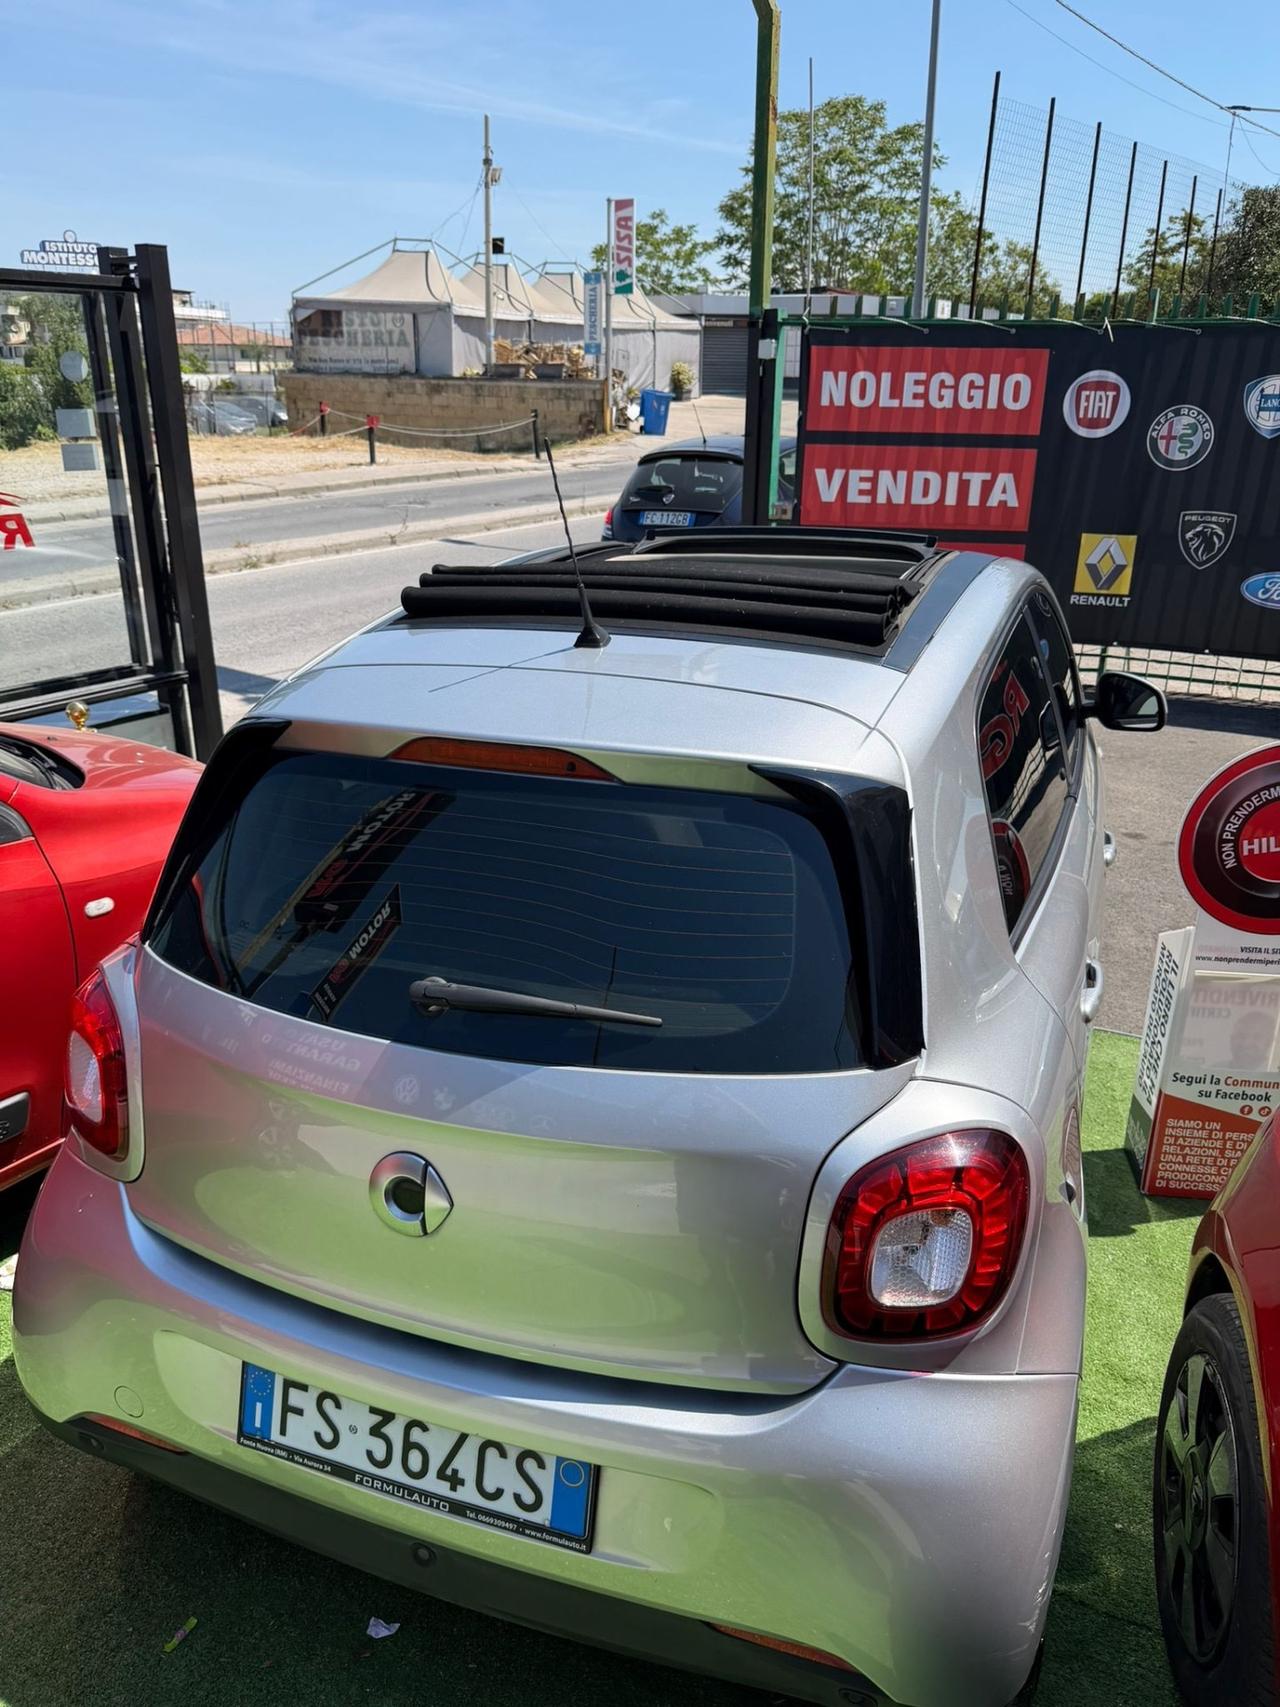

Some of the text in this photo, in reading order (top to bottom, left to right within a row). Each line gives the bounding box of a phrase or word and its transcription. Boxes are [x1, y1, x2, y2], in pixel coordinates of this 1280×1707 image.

[44, 241, 97, 254] ISTITUTO
[615, 215, 634, 269] SISA
[588, 285, 598, 342] PESCHERIA
[820, 370, 1032, 411] NOLEGGIO
[1078, 390, 1117, 419] FIAT
[1151, 407, 1211, 440] ALFA ROMEO
[814, 467, 1019, 508] VENDITA
[1184, 515, 1232, 523] PEUGEOT
[1070, 595, 1131, 607] RENAULT
[1222, 842, 1238, 869] NON
[1151, 941, 1166, 1013] MERCATO
[1146, 949, 1172, 1079] RIVOLUZIONATO
[1146, 959, 1179, 1106] IL LIBRO CHE HA
[1172, 1072, 1280, 1089] Segui la Commun
[1198, 1089, 1271, 1102] su Facebook
[1166, 1119, 1220, 1130] SIAMO UN
[1165, 1128, 1209, 1138] INSIEME
[1211, 1131, 1223, 1139] DI
[1163, 1136, 1175, 1145] DI
[1176, 1137, 1223, 1149] AZIENDE
[1225, 1140, 1233, 1149] E
[1160, 1153, 1183, 1163] UNA
[1185, 1156, 1214, 1166] RETE
[1216, 1158, 1228, 1166] DI
[1157, 1170, 1227, 1184] PRODUCONO
[1158, 1162, 1218, 1175] CONNESSE
[1155, 1179, 1167, 1187] DI
[294, 1454, 302, 1463] Via
[303, 1458, 323, 1470] Aurora
[354, 1474, 449, 1512] FORMULAUTO
[466, 1510, 477, 1520] Tel.
[524, 1528, 587, 1551] www.formulauto.it
